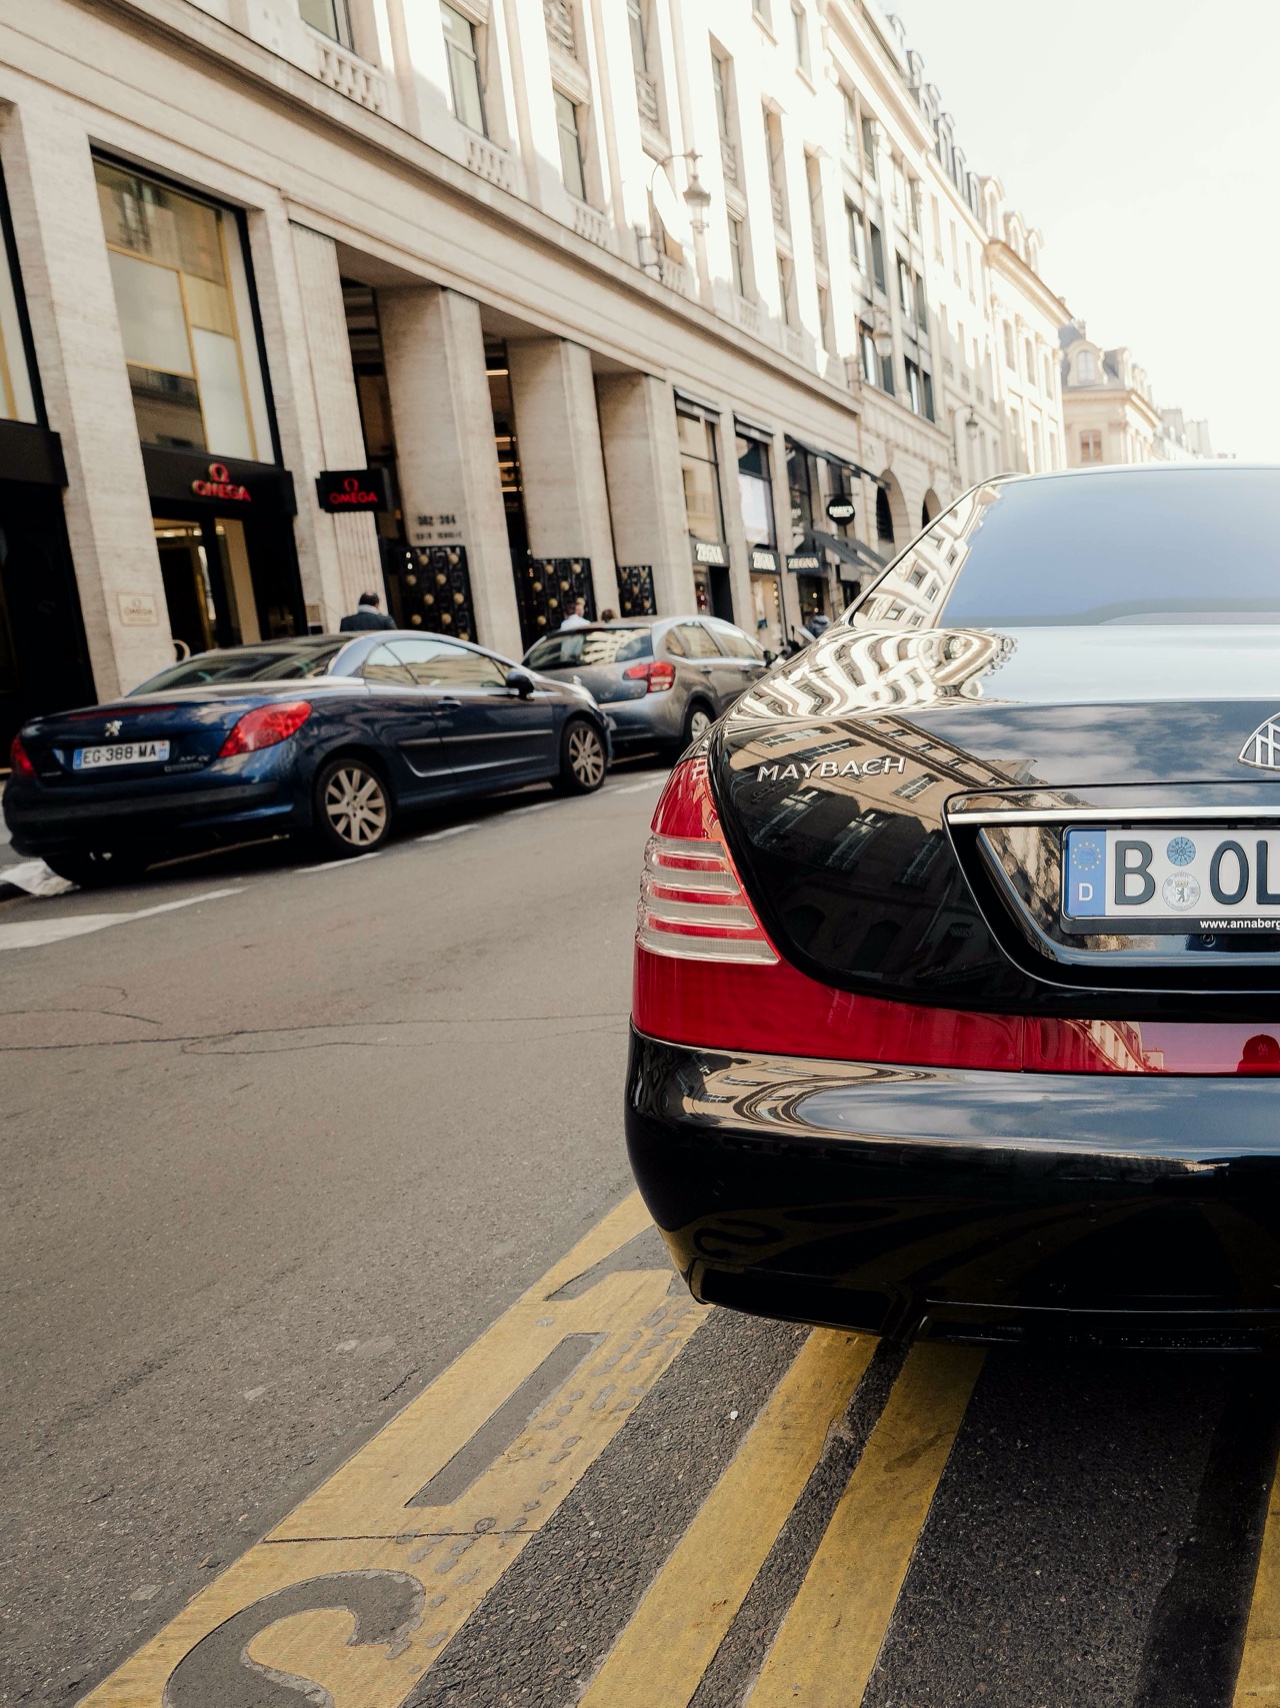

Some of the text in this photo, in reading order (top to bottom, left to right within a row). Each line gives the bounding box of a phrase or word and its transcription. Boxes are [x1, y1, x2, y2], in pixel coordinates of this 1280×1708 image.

[192, 480, 251, 500] OMEGA
[329, 491, 378, 504] OMEGA
[696, 543, 724, 564] ZEGNA
[753, 551, 776, 571] ZEGNA
[788, 557, 819, 569] ZEGNA
[756, 756, 907, 782] MAYBACH
[1114, 840, 1156, 905] B
[1078, 882, 1094, 902] D
